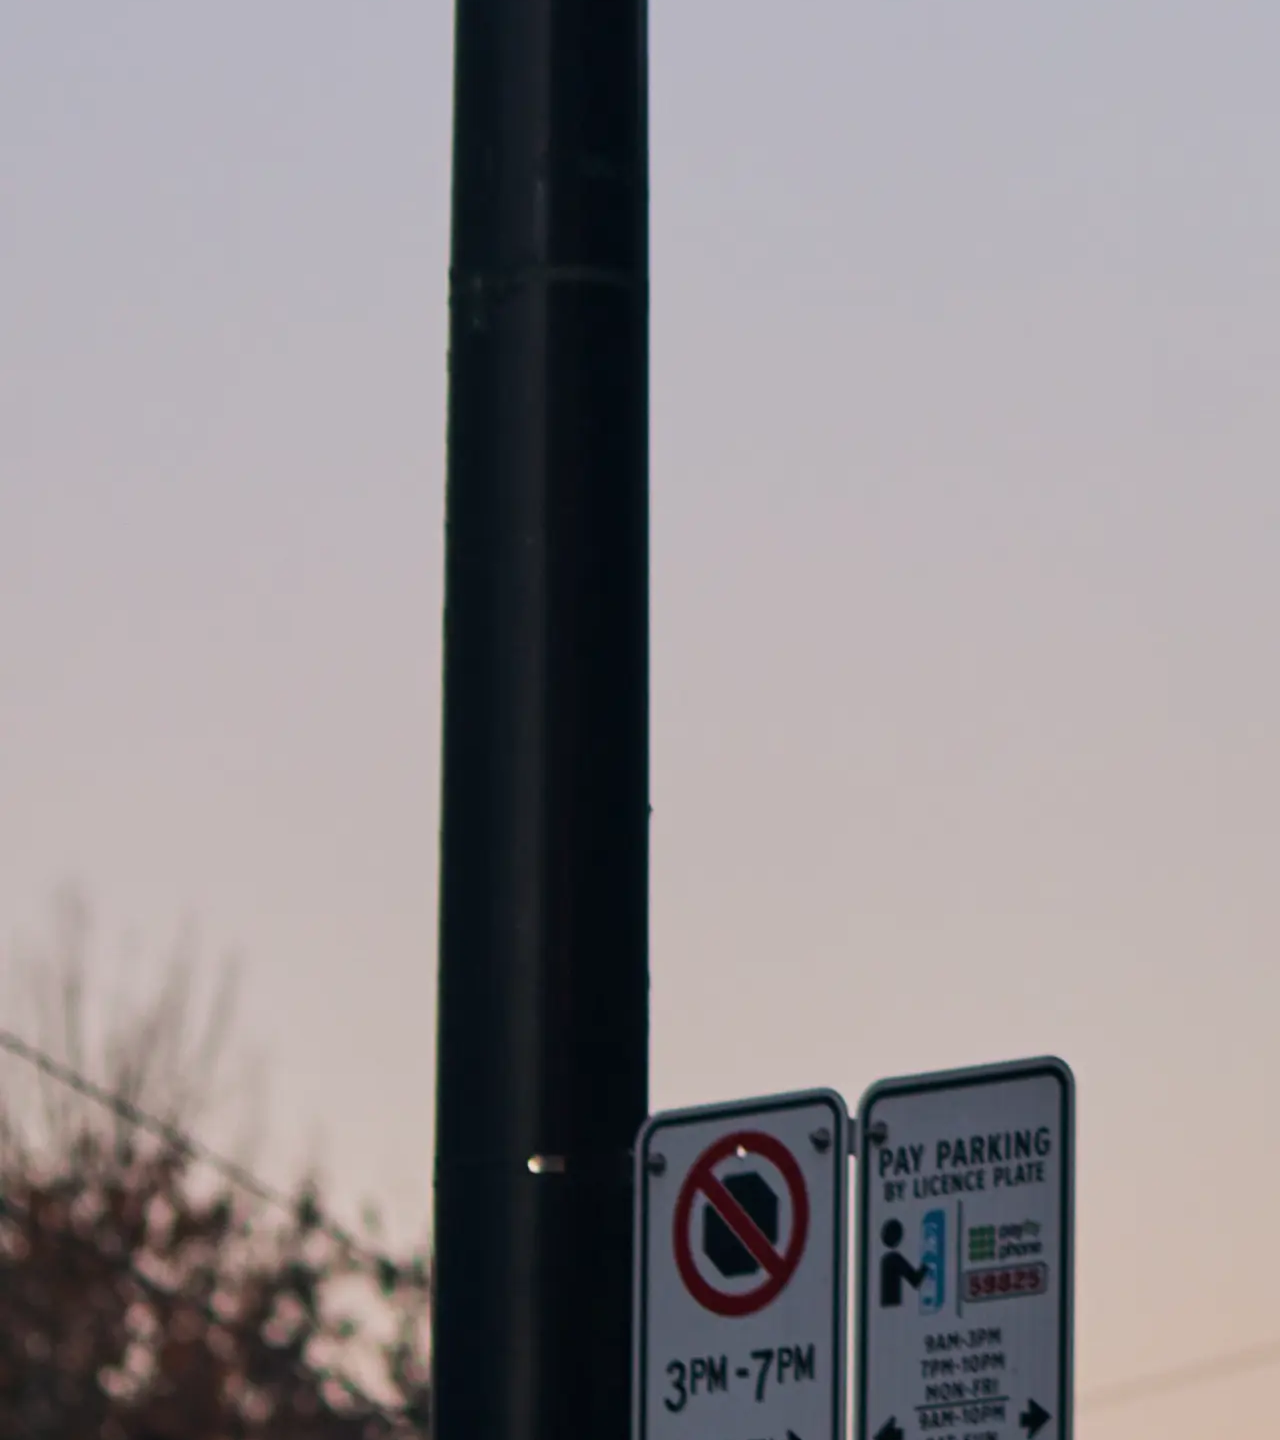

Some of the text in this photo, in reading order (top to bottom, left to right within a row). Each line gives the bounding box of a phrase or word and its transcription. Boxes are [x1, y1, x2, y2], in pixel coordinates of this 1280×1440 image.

[878, 1126, 1051, 1178] PAY PARKING
[884, 1160, 1046, 1203] BY LICENCE PLATE
